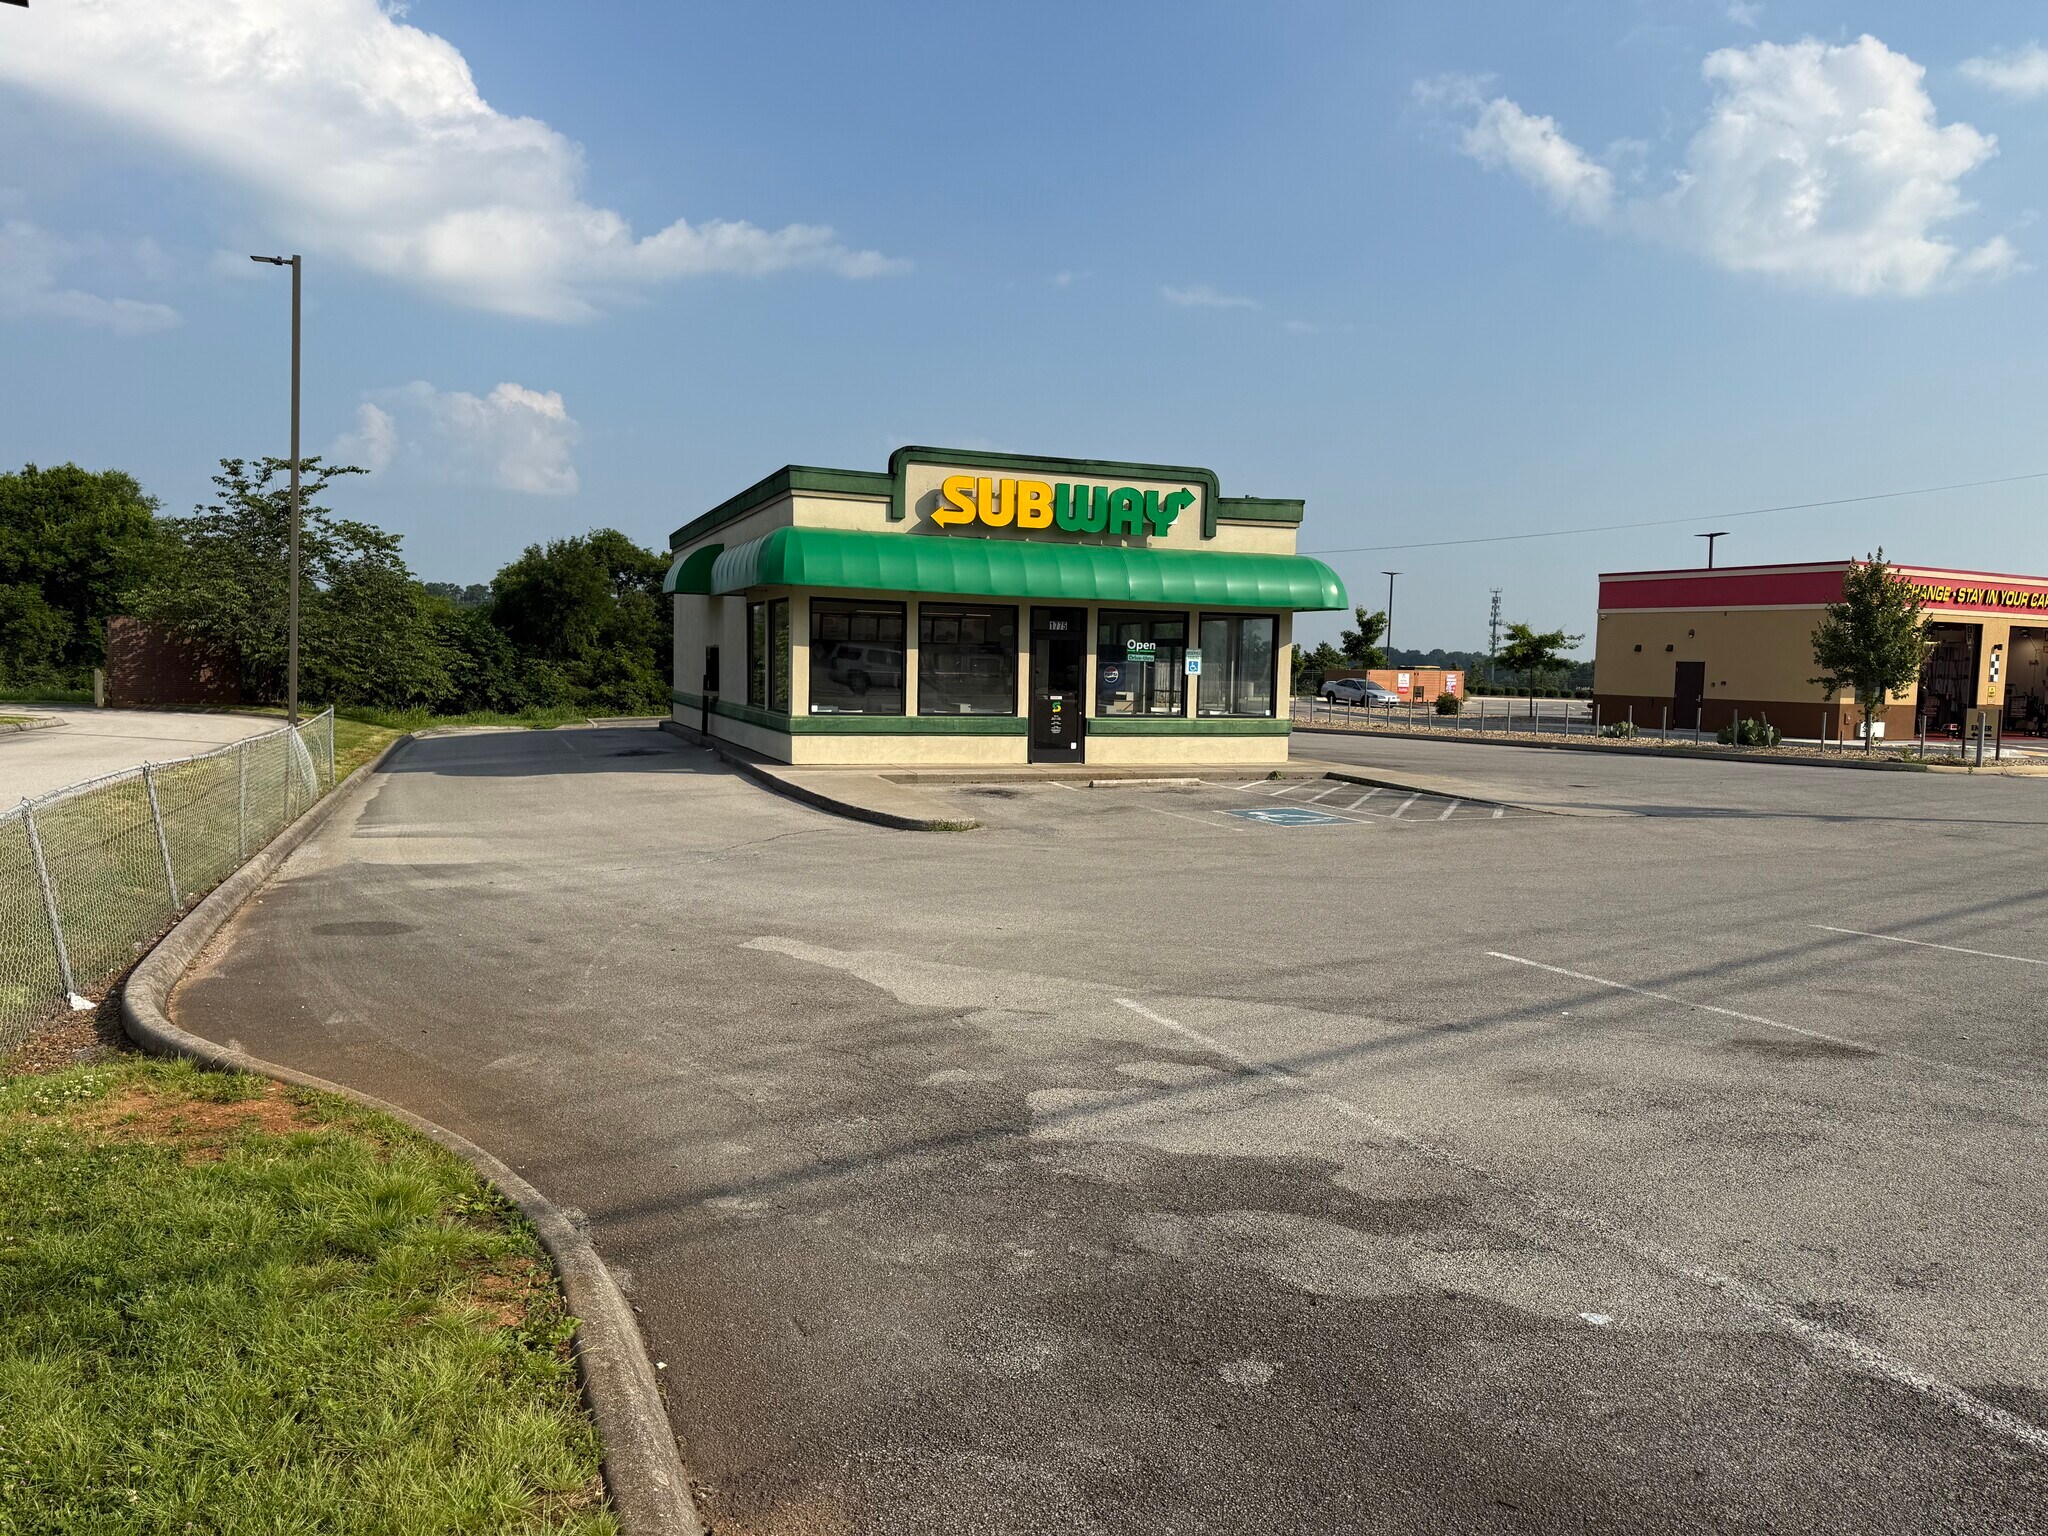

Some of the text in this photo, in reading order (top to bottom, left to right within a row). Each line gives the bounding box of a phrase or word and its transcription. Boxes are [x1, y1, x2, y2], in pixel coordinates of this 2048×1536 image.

[930, 475, 1196, 537] SUBWAY
[1957, 587, 1985, 603] STAY
[1986, 589, 1999, 604] IN
[2000, 590, 2030, 606] YOUR
[1049, 620, 1068, 630] 1775
[1127, 639, 1156, 652] Open
[1971, 724, 1993, 732] ENER
